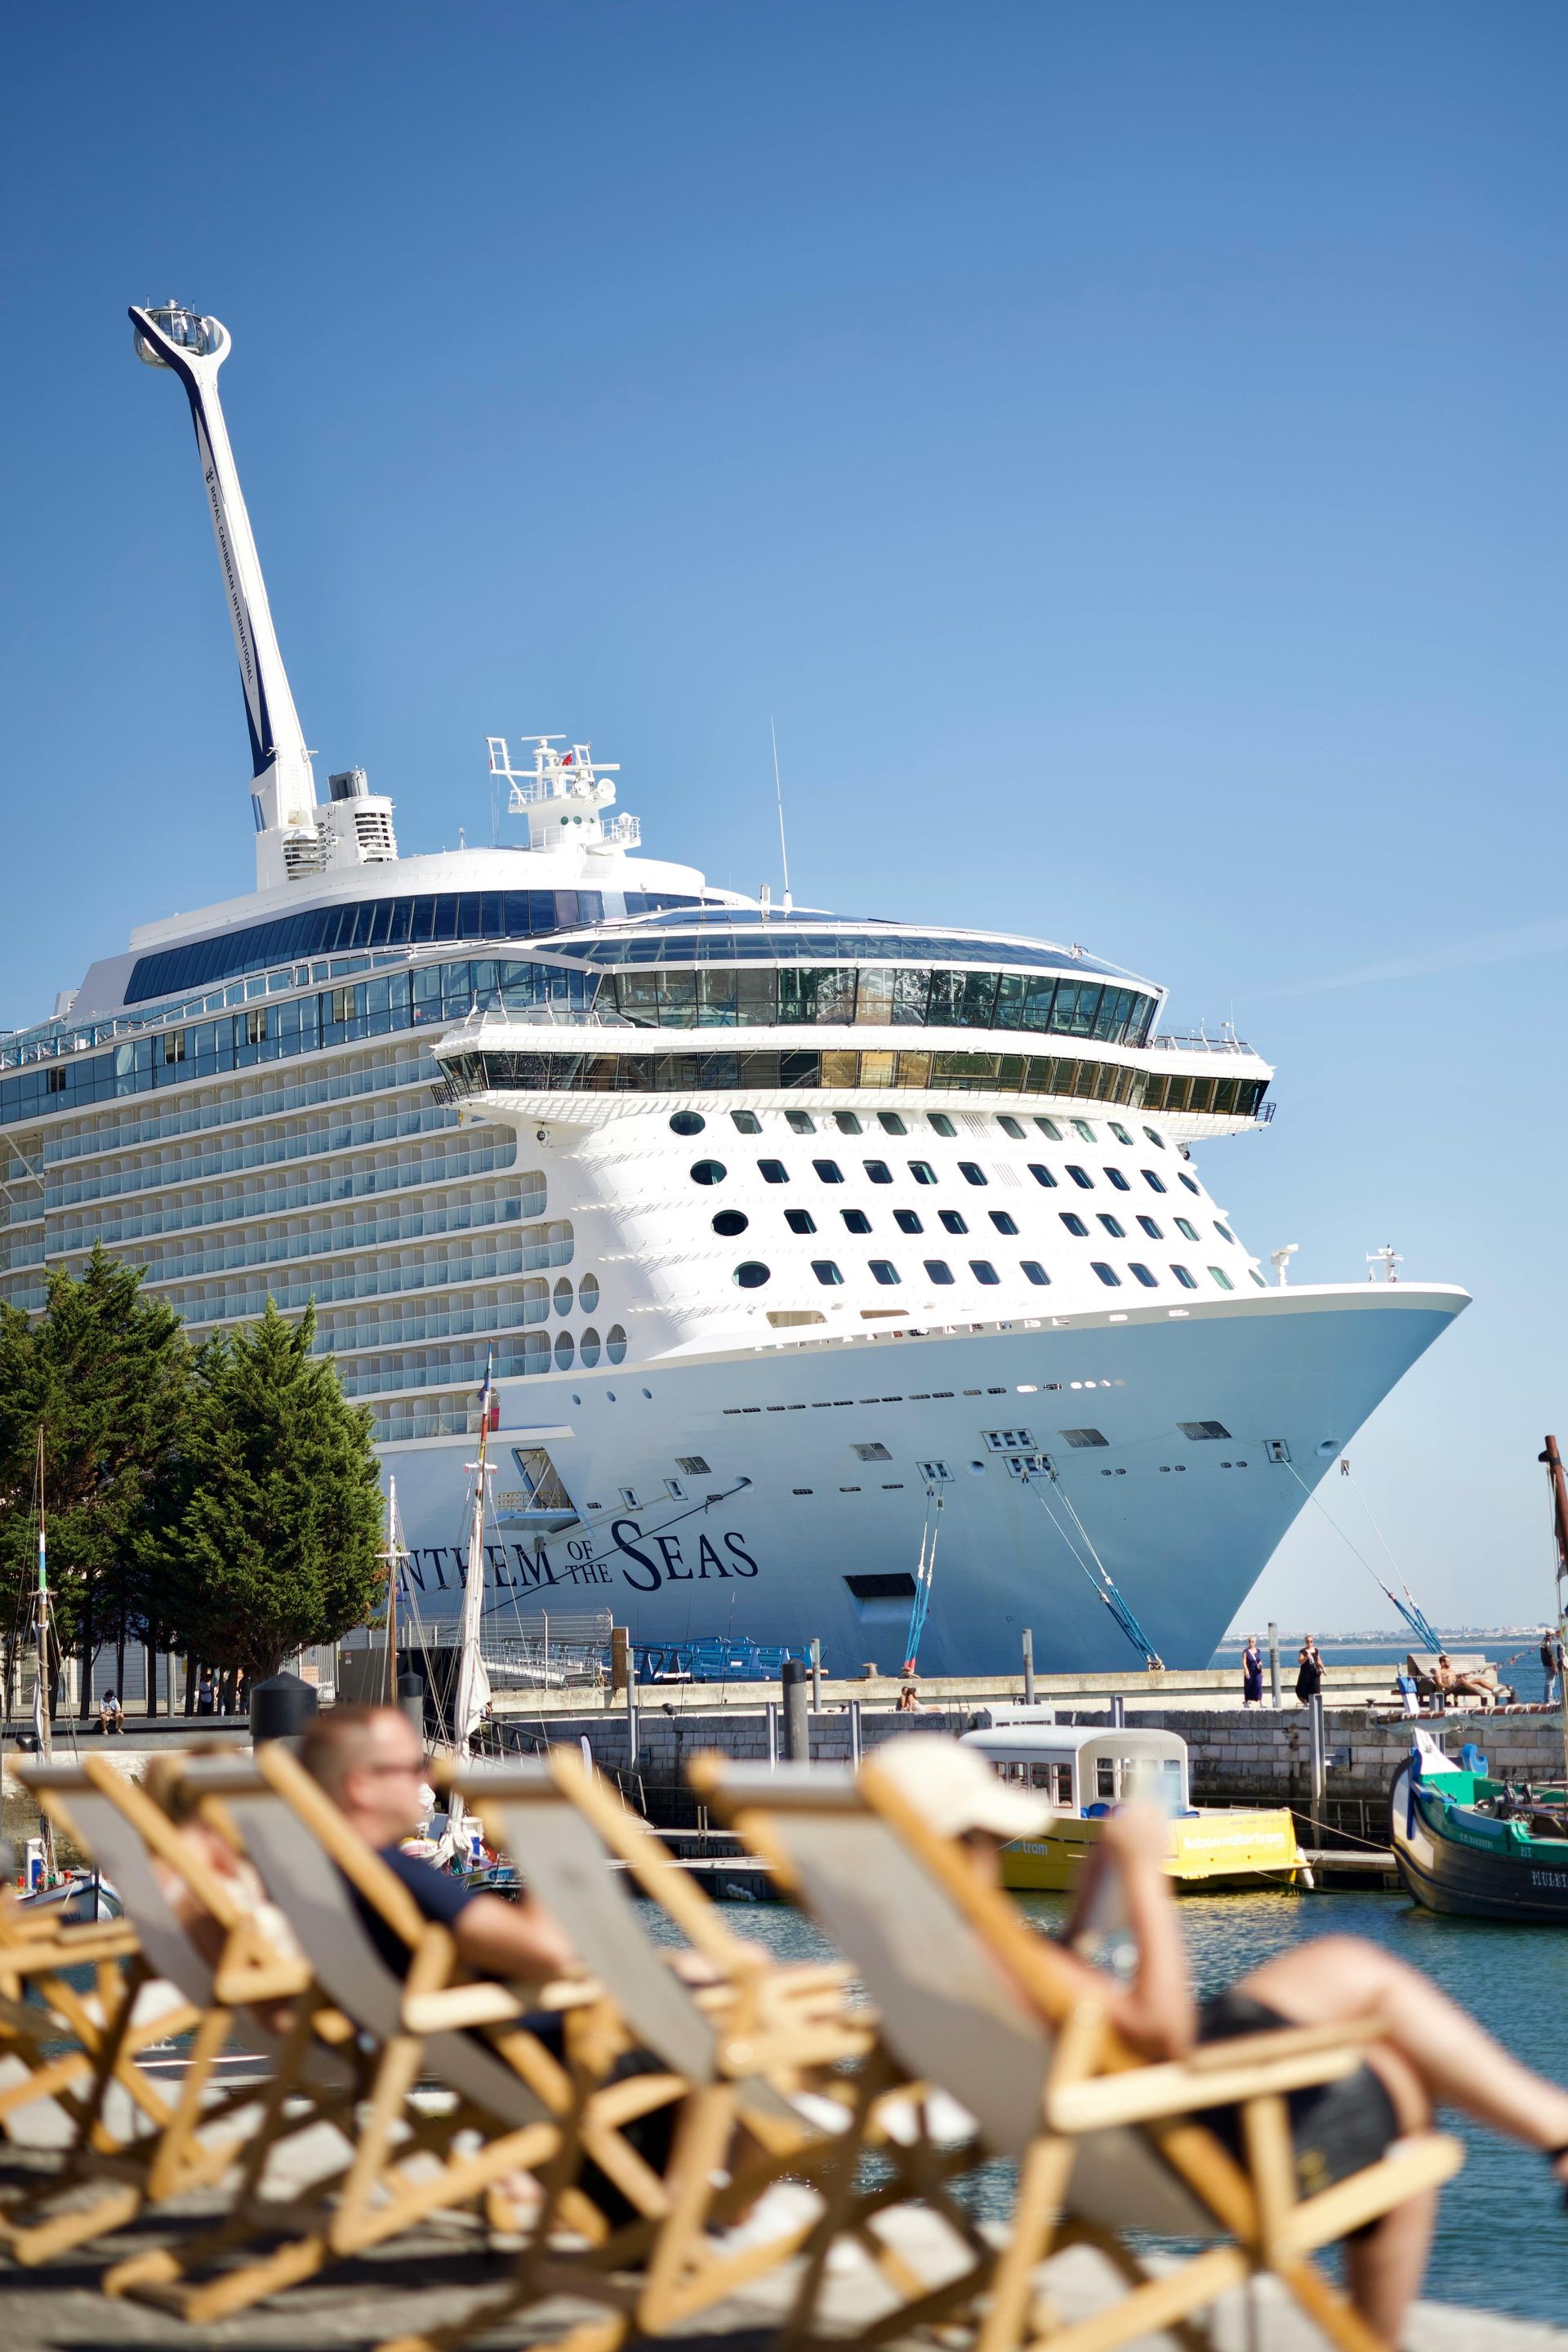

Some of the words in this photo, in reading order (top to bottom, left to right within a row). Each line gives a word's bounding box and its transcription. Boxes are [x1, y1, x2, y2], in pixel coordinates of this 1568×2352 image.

[210, 485, 221, 523] ROYAL
[218, 526, 235, 590] CARIBBEAN
[232, 593, 253, 684] INTERNATIONAL
[397, 1543, 560, 1592] NTHEM
[565, 1563, 612, 1584] THE
[567, 1540, 593, 1561] OF
[611, 1520, 759, 1592] SEAS
